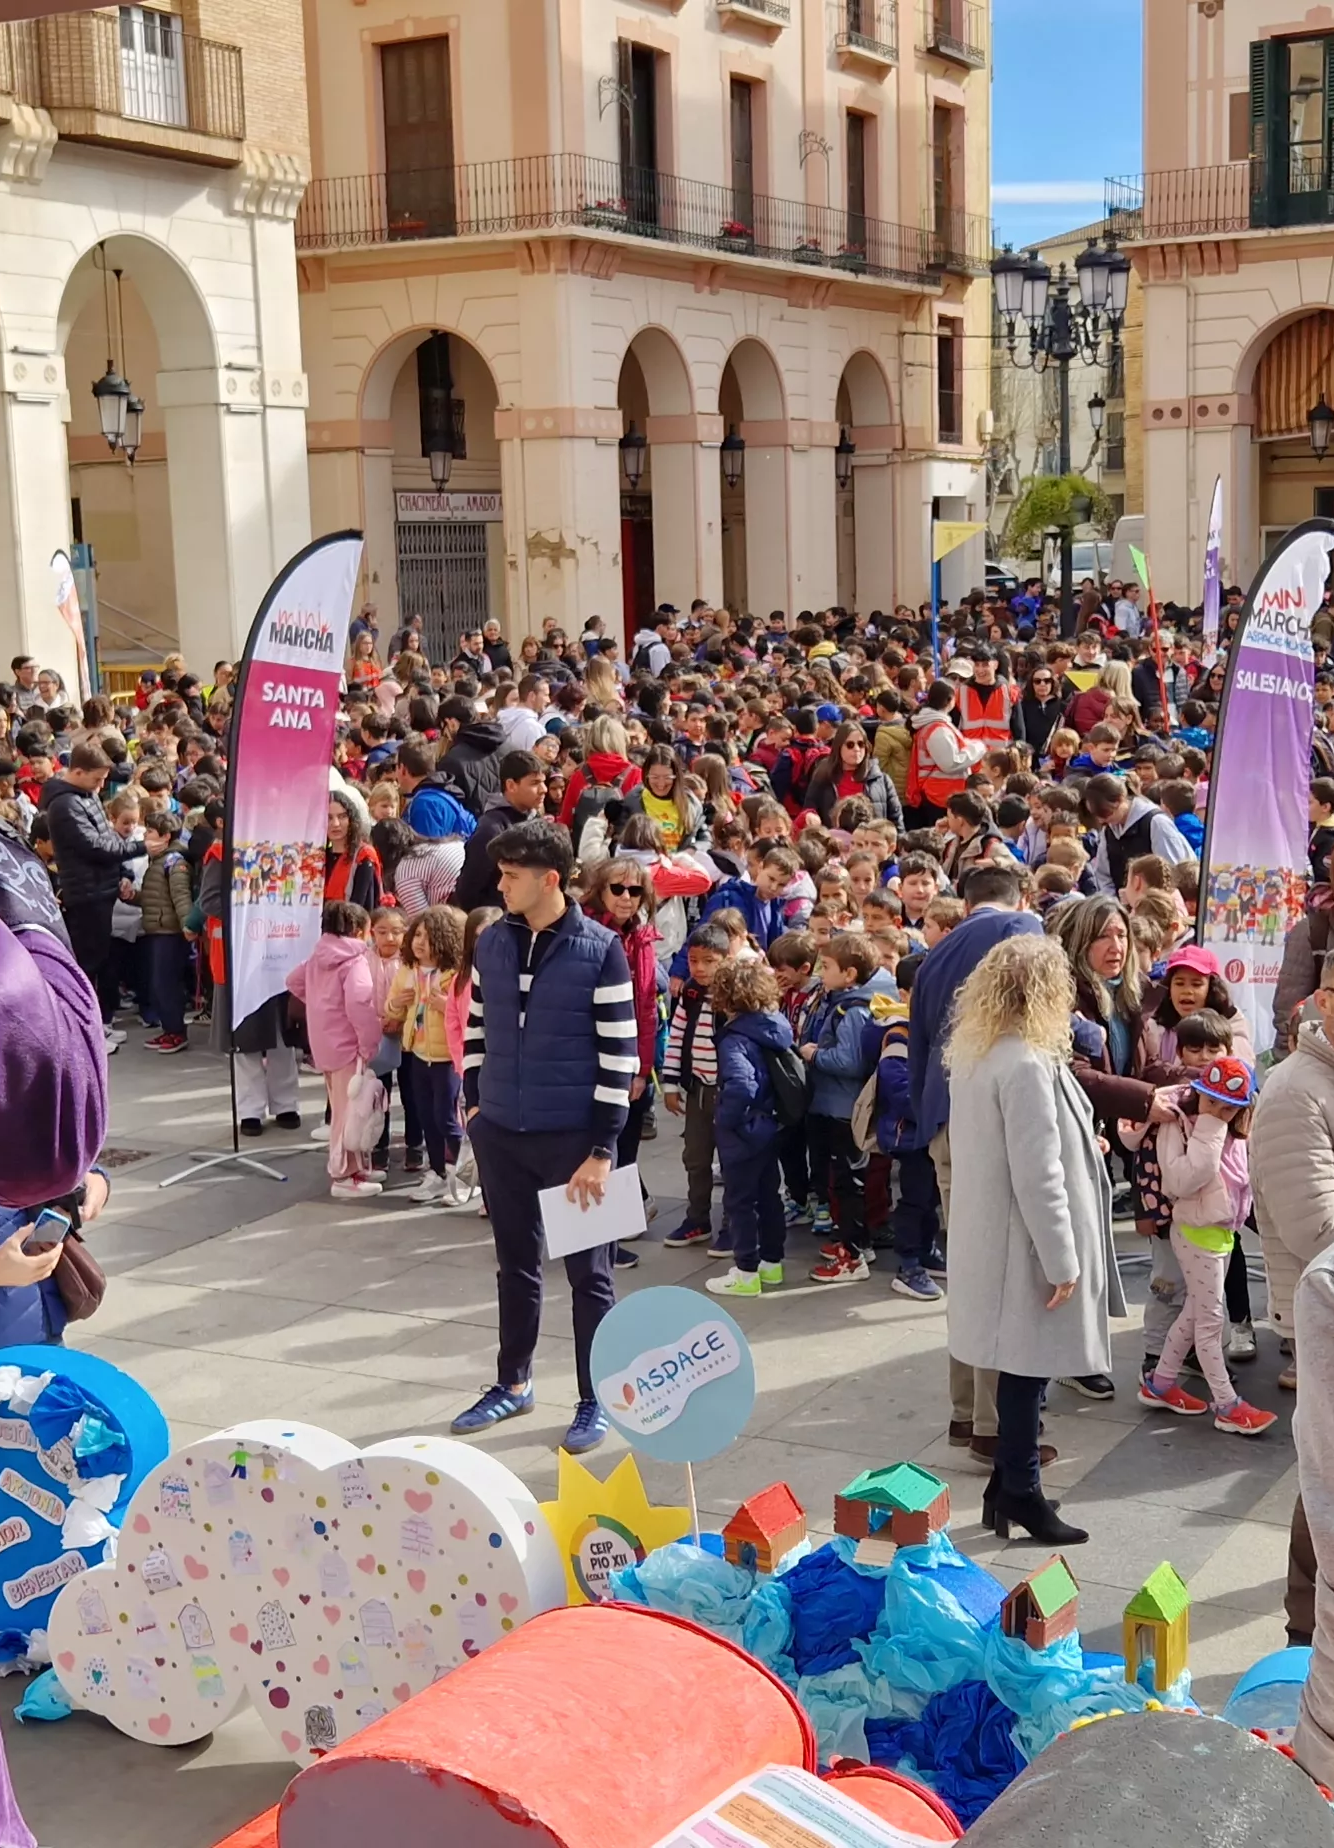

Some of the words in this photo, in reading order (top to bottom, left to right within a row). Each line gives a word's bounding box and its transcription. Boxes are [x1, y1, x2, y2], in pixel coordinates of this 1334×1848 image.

[466, 496, 496, 511] AMADO
[269, 621, 335, 653] MARCHA
[1247, 607, 1312, 641] MARCH
[262, 681, 326, 709] SANTA
[269, 707, 313, 731] ANA
[635, 1330, 725, 1397] ASPACE
[589, 1541, 613, 1555] CEIP
[590, 1556, 610, 1571] PIO
[612, 1554, 628, 1568] XII
[8, 1556, 85, 1604] BIENESTAR
